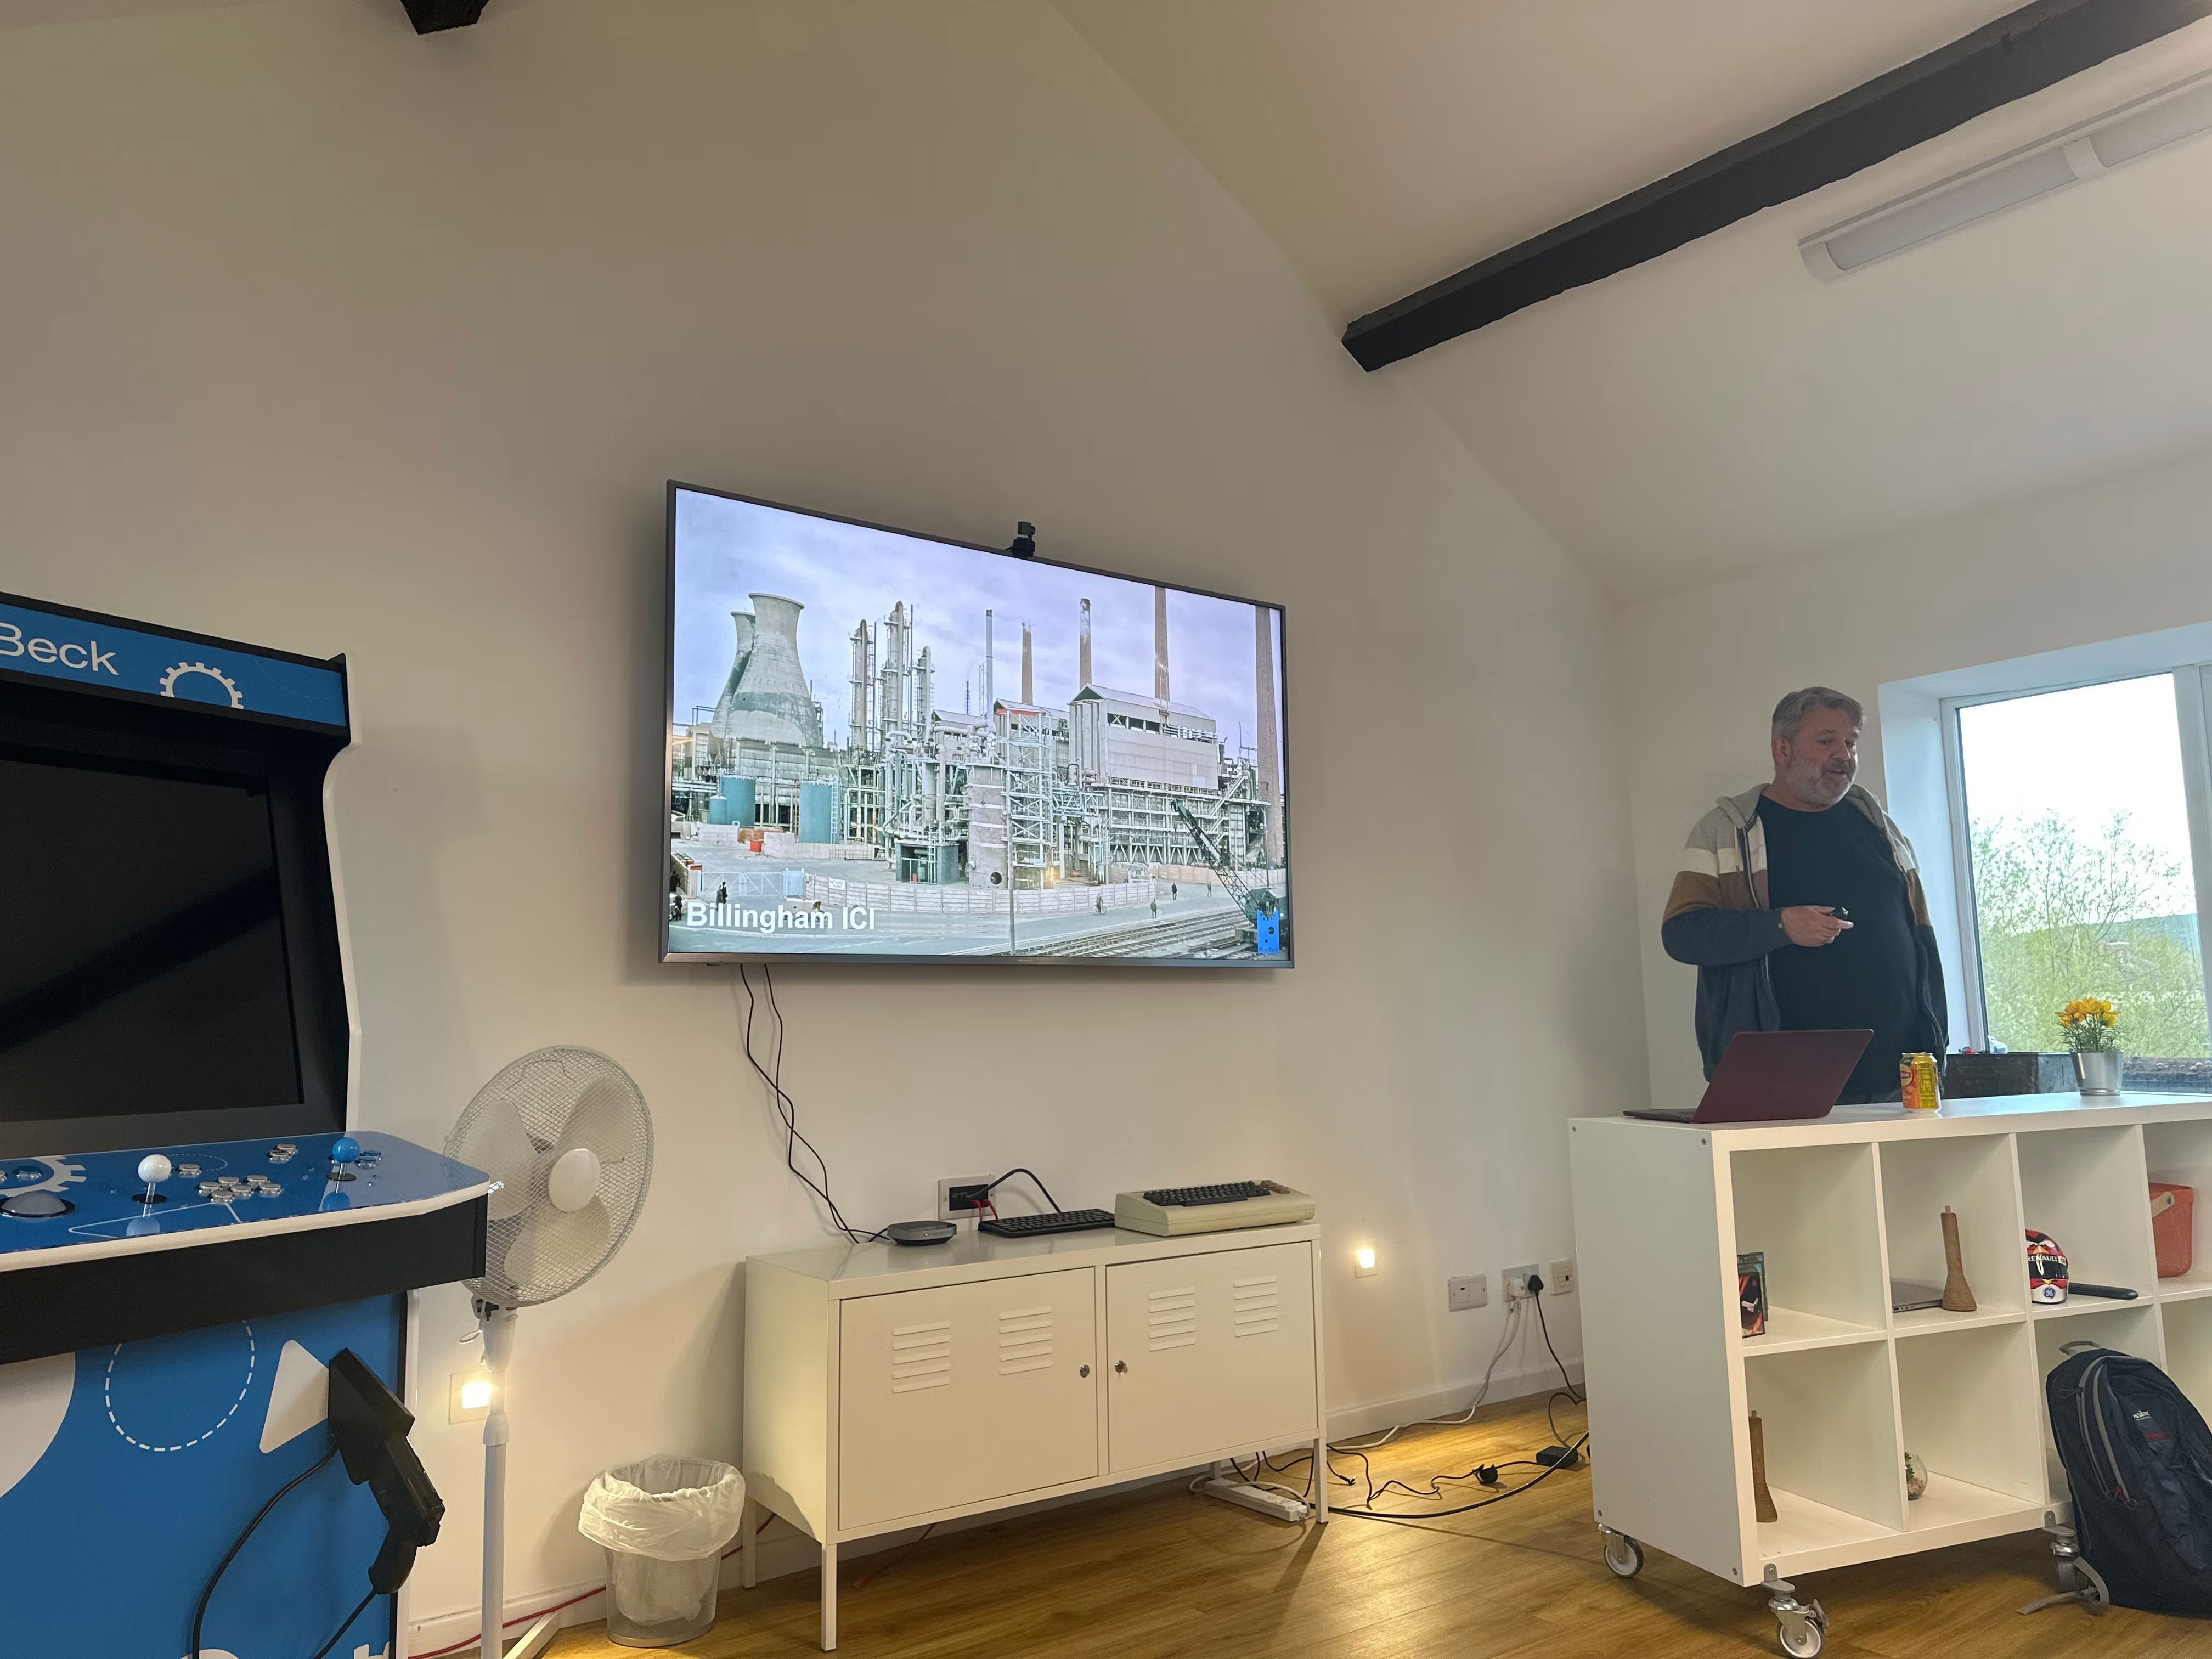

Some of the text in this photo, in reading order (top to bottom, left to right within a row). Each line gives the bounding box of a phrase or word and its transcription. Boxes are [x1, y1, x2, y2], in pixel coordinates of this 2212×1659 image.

[0, 622, 119, 675] Beck
[687, 901, 874, 934] Billingham ICI
